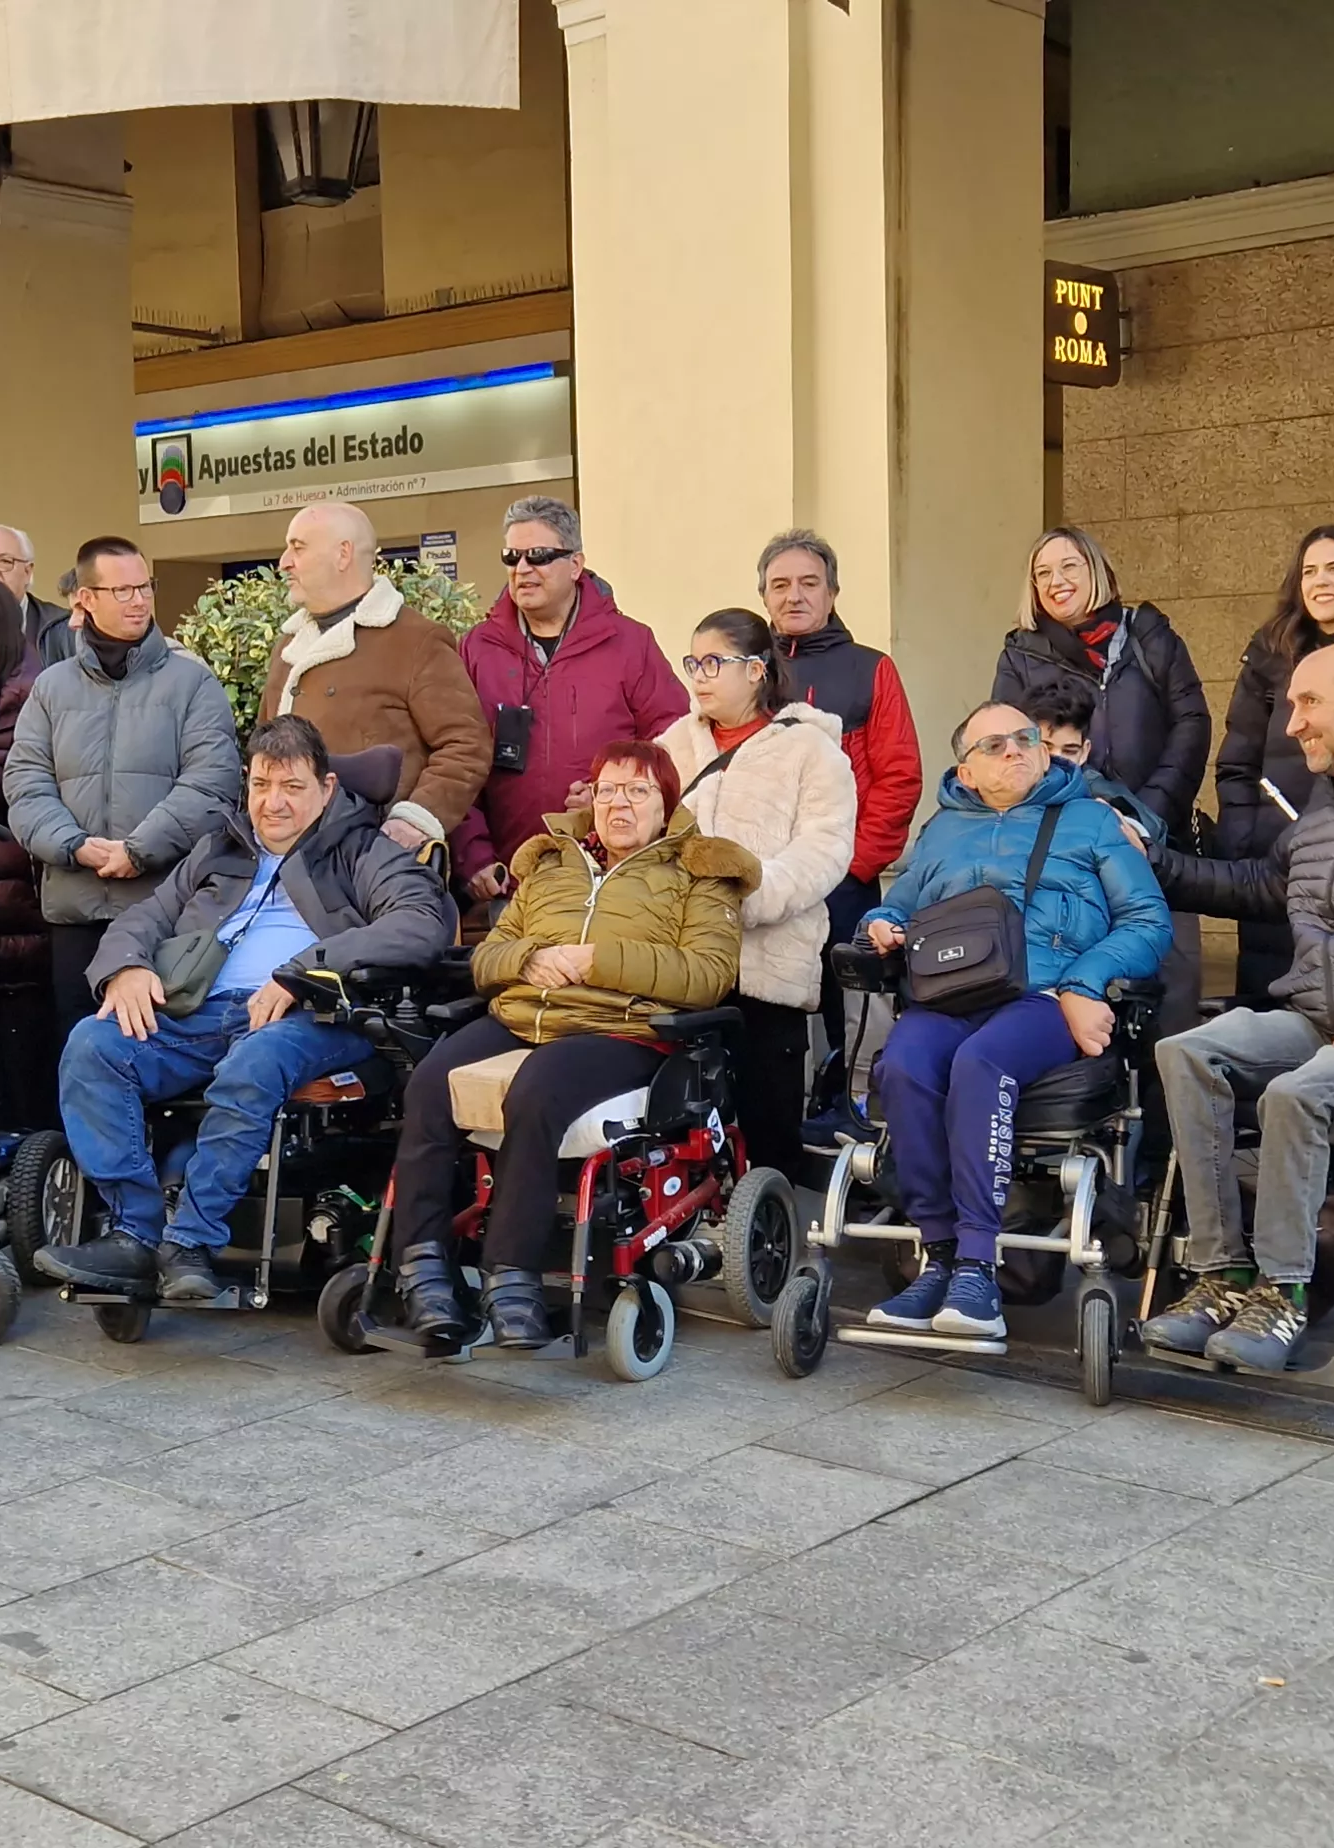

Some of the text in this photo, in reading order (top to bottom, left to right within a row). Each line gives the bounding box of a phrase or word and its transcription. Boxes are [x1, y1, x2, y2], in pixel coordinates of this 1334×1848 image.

[1055, 279, 1104, 310] PUNT
[1054, 335, 1108, 367] ROMA
[138, 424, 424, 495] y Apuestas del Estado
[263, 496, 273, 507] La
[275, 495, 280, 506] 7
[282, 493, 294, 504] de
[296, 490, 326, 503] Huesca
[336, 479, 405, 498] Administración
[420, 477, 426, 489] 7
[988, 1113, 999, 1162] LONDON
[992, 1074, 1017, 1206] LONSDALE
